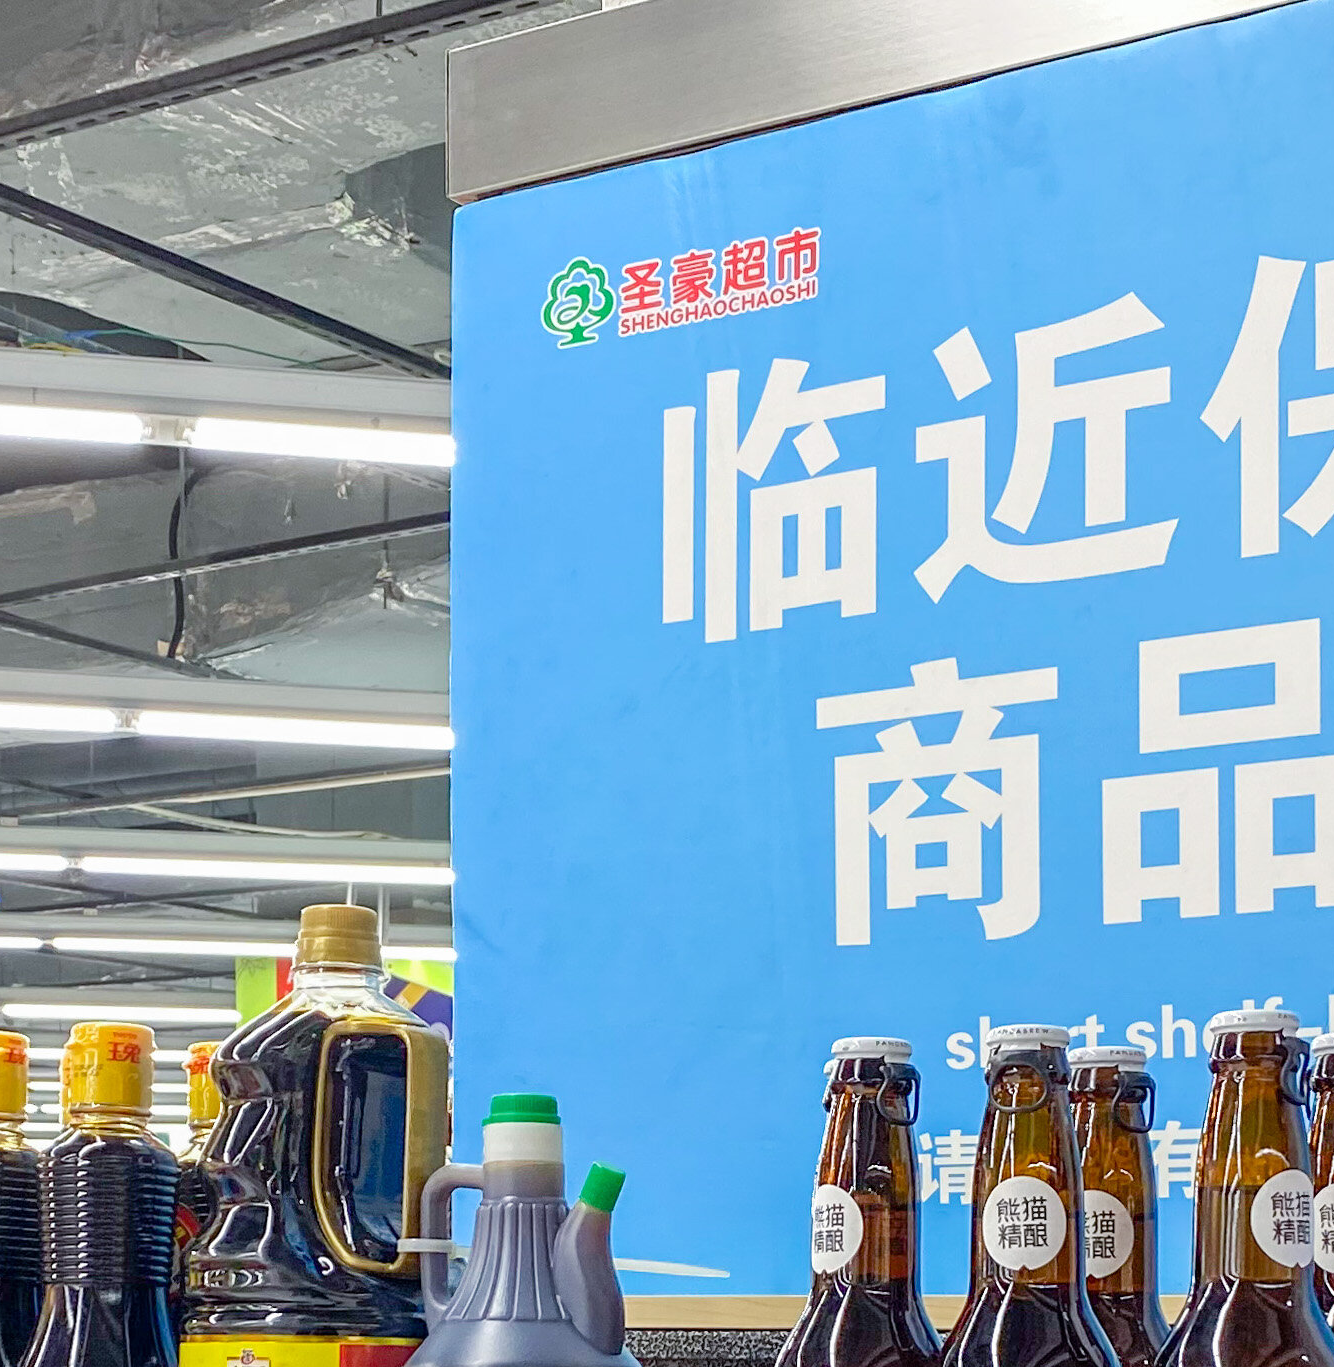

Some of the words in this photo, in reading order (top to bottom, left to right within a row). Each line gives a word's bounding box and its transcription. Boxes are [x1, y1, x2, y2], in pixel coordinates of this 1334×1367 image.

[620, 229, 819, 314] 圣豪超市
[620, 279, 816, 335] SHENGHAOCHAOSHI
[996, 1196, 1048, 1223] 熊猫
[997, 1223, 1049, 1250] 精酿
